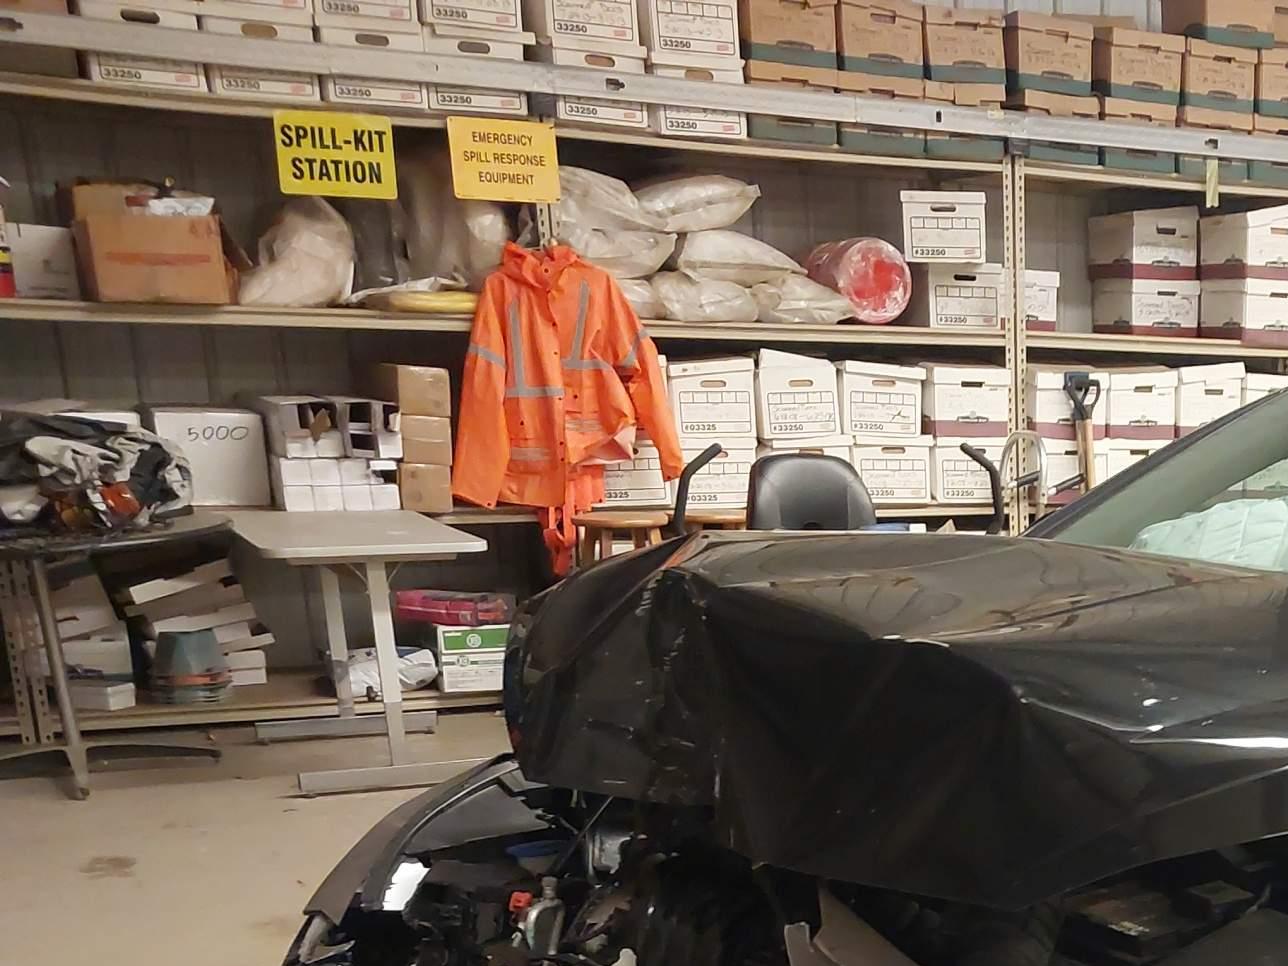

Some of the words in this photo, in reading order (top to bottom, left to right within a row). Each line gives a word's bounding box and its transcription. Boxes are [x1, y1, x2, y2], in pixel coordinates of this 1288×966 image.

[435, 9, 468, 19] 33250
[556, 22, 588, 33] 33250
[662, 38, 692, 49] 33250
[103, 67, 142, 80] 33250
[225, 79, 260, 90] 33250
[337, 87, 372, 97] 33250
[439, 94, 473, 105] 33250
[567, 105, 598, 116] 33250
[668, 120, 698, 130] 33250
[280, 123, 387, 153] SPILL-KIT
[471, 131, 533, 147] EMERGENCY
[463, 150, 491, 163] SPILL
[493, 153, 546, 167] RESPONSE
[291, 156, 383, 184] STATION
[478, 170, 535, 185] EQUIPMENT
[187, 425, 249, 441] 5000
